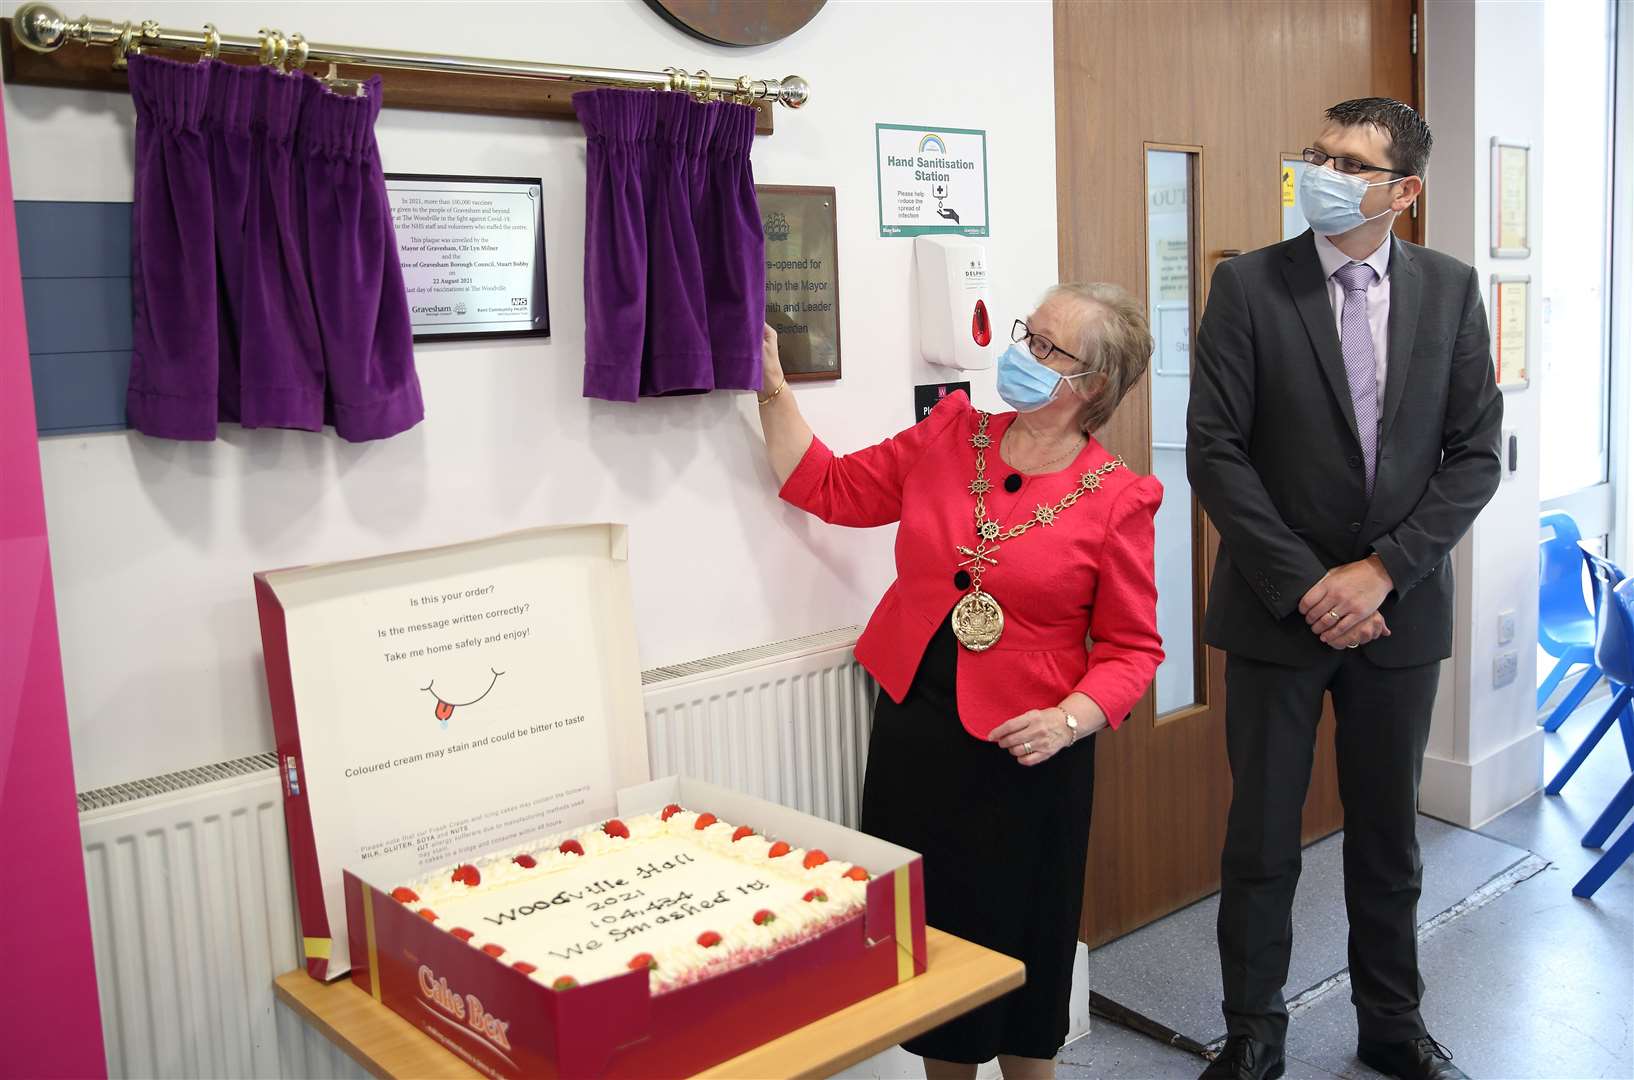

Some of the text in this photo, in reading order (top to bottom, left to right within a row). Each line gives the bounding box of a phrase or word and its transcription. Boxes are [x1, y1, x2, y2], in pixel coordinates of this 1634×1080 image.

[888, 156, 974, 170] Hand Sanitisation
[914, 170, 950, 182] Station
[766, 258, 821, 271] e-opened for
[784, 280, 828, 293] the Mayor
[783, 302, 800, 312] and
[802, 301, 832, 312] Leader
[410, 585, 495, 607] Is this your order?
[378, 603, 530, 638] Is the message written correctly?
[384, 627, 530, 662] Take me home safely and enjoy!
[344, 715, 585, 778] Coloured cream may stain and could be bitter to taste
[416, 835, 435, 845] SOYA
[450, 825, 468, 835] NUTS
[360, 843, 383, 852] Please
[483, 854, 694, 926] Woodville Hall
[586, 889, 645, 911] 2021
[548, 940, 603, 959] We
[609, 890, 730, 942] Smashed
[418, 964, 466, 1020] Cake
[466, 994, 512, 1051] Box
